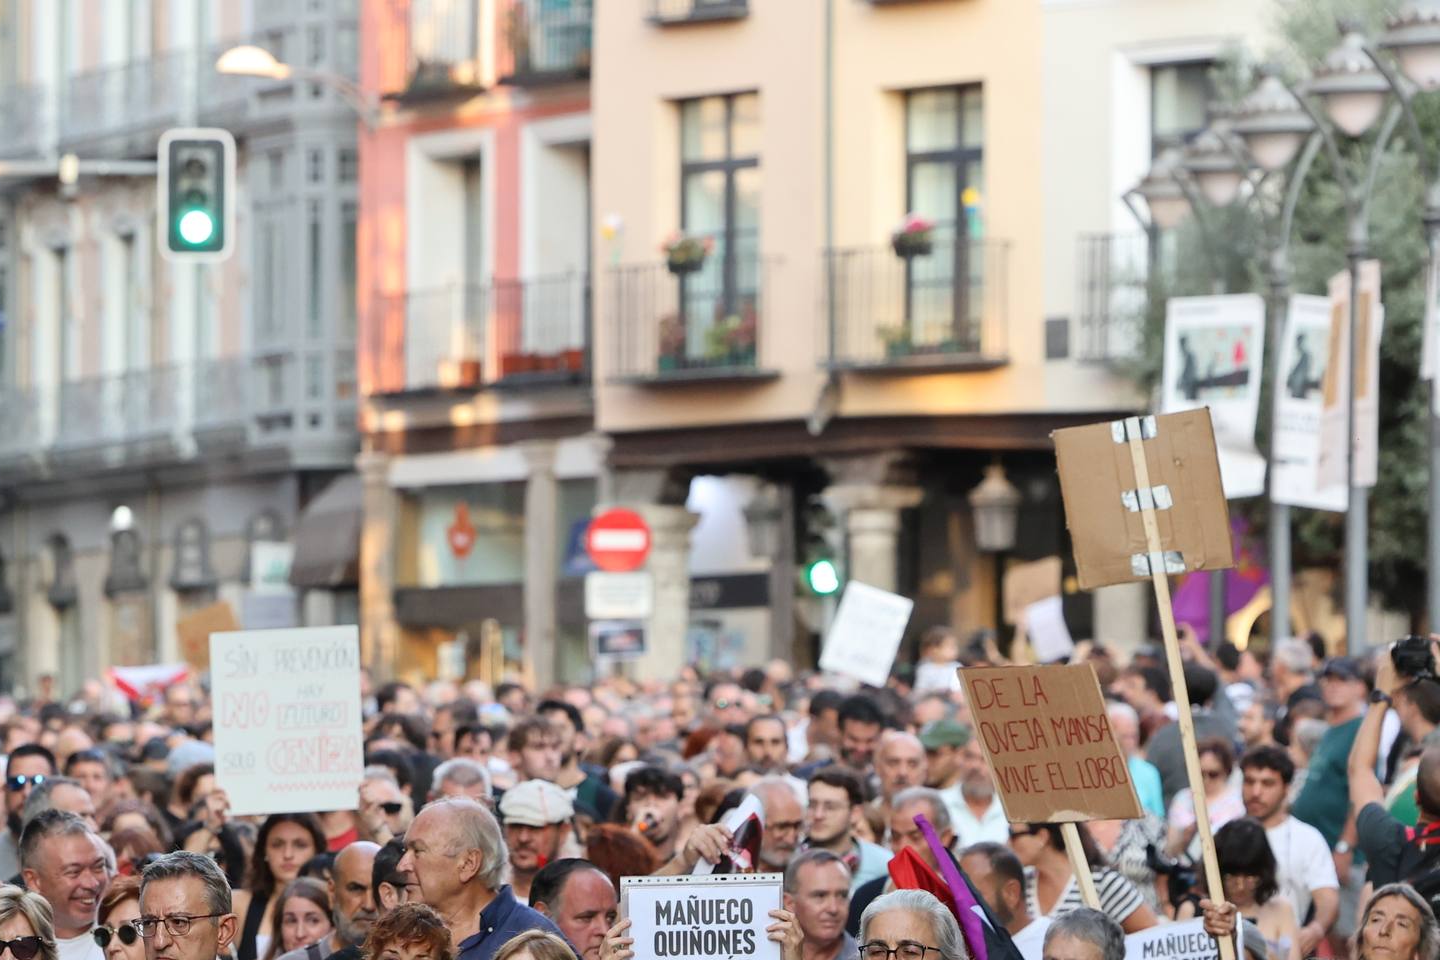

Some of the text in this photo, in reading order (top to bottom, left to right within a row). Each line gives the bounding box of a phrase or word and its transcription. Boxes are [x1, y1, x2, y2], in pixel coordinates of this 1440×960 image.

[221, 691, 269, 729] NO
[972, 675, 1049, 710] DE LA
[980, 714, 1114, 755] OVEJA MANSA
[994, 755, 1129, 793] VIVE EL LOBO
[655, 895, 753, 926] MAÑUECO
[654, 926, 756, 957] QUIÑONES
